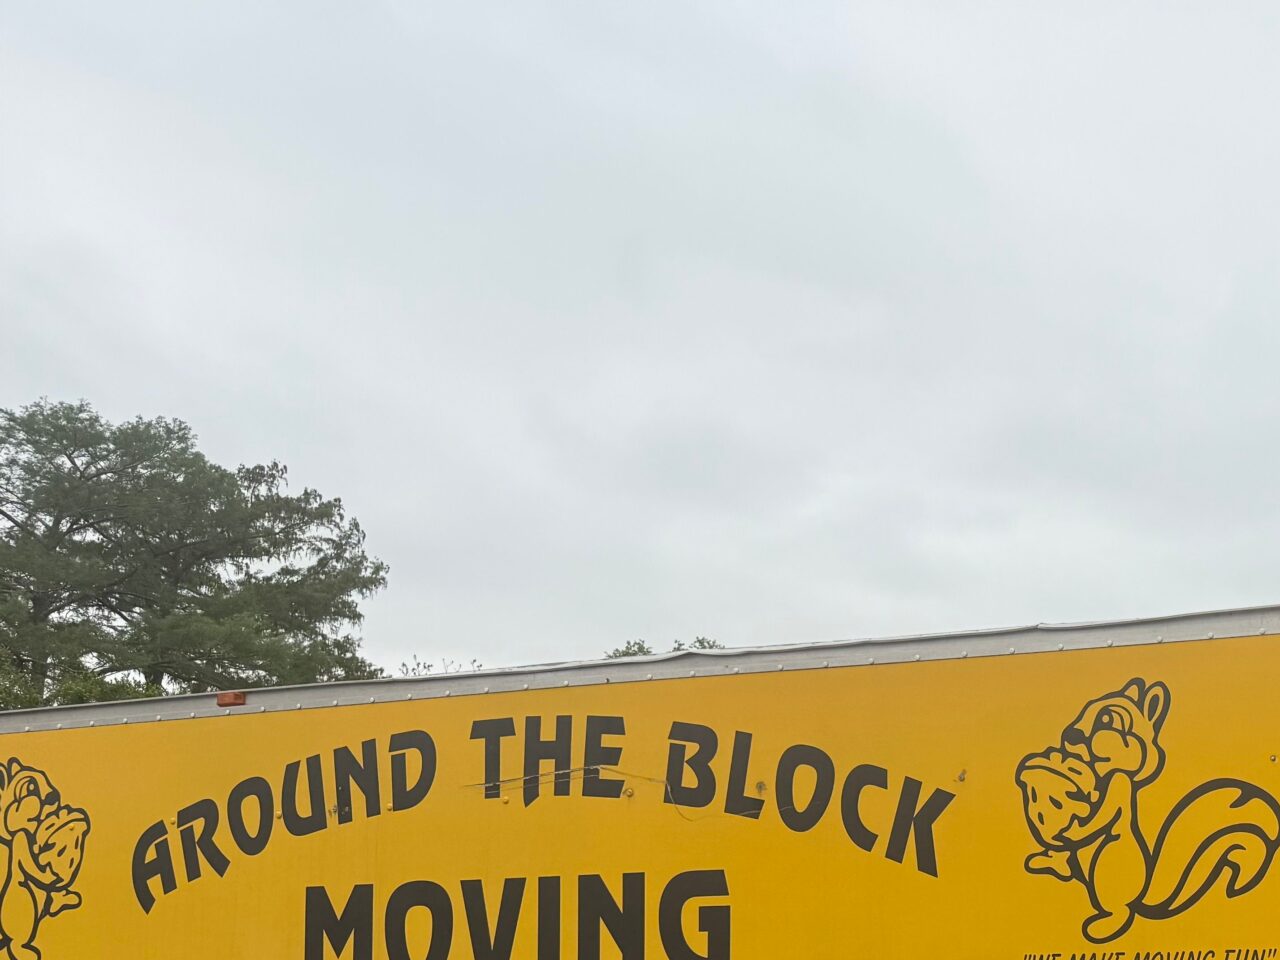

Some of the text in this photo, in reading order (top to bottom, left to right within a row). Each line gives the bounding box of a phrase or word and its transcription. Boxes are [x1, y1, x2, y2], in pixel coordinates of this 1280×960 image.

[131, 715, 956, 914] AROUND THE BLOCK
